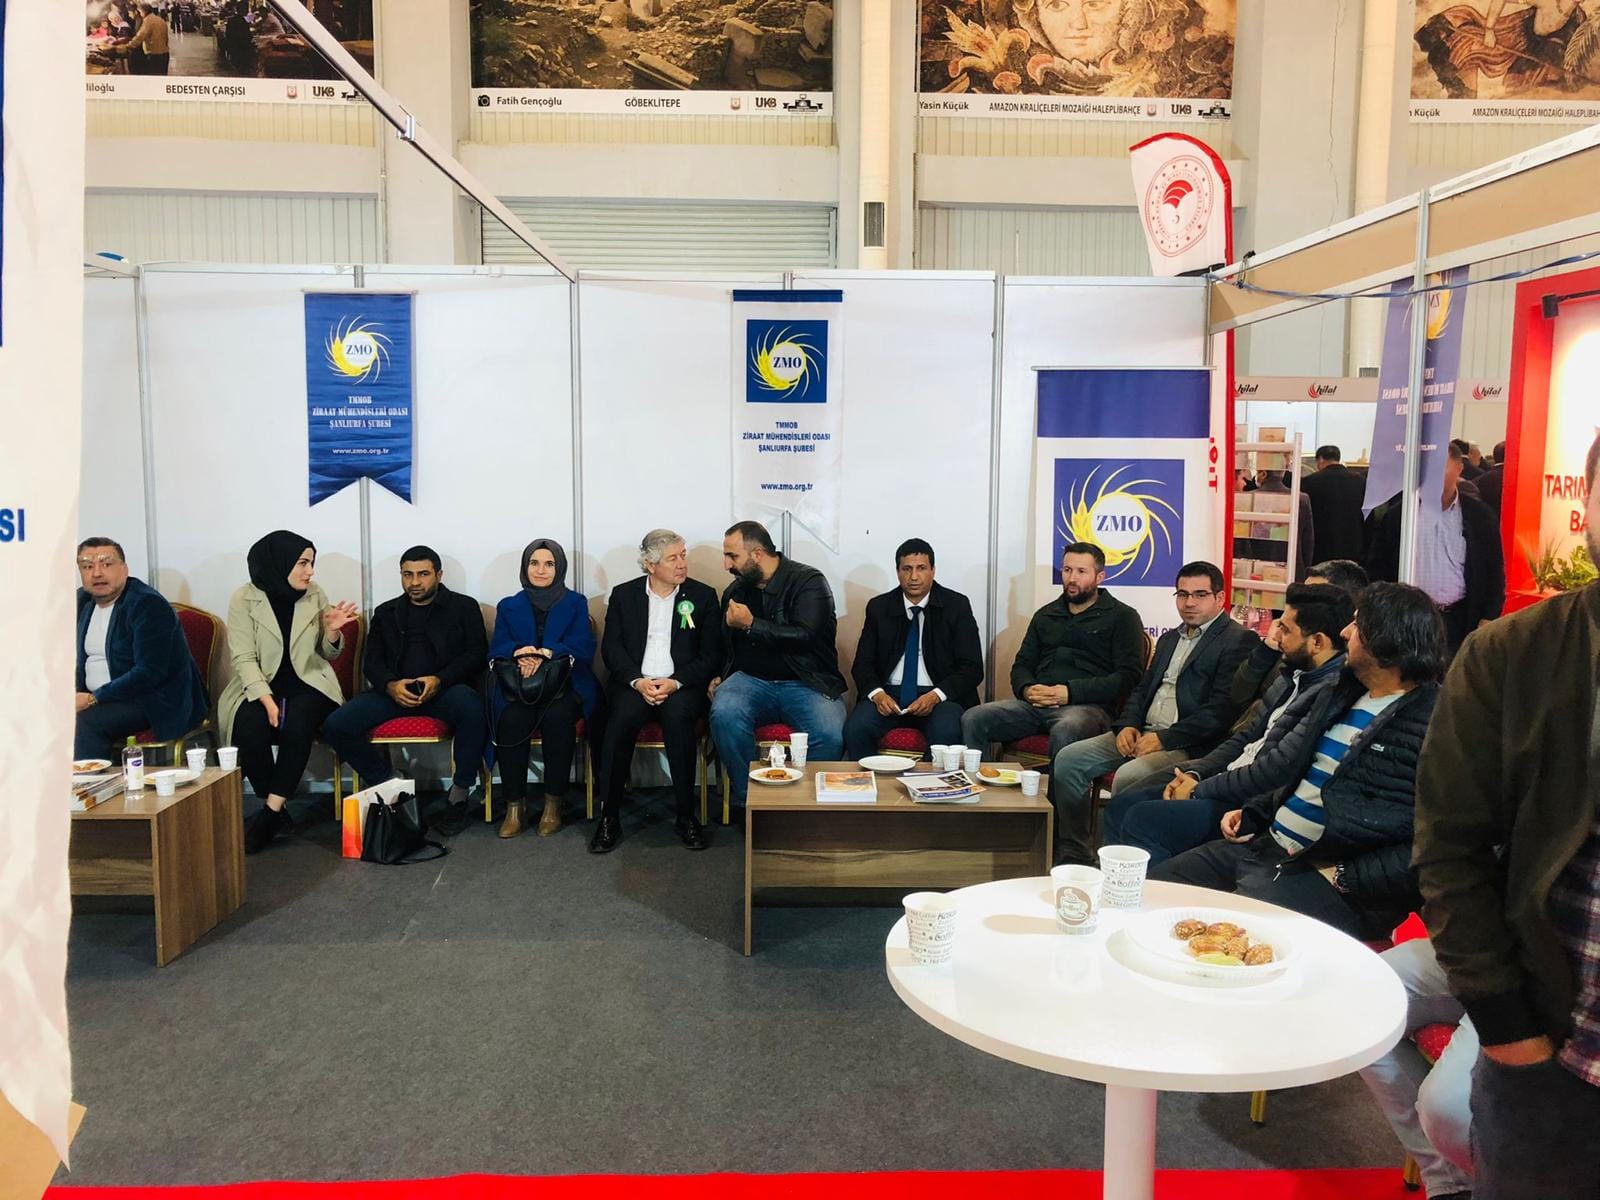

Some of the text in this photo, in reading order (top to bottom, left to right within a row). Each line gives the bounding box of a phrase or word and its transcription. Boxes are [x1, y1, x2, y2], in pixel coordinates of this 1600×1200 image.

[165, 84, 246, 97] BEDESTEN ÇARŞISI
[496, 96, 562, 108] Fatih Gençoğlu
[624, 97, 680, 108] GÖBEKLİTEPE
[920, 102, 969, 112] Yasin Küçük
[989, 102, 1140, 116] AMAZON KRALİÇELERİ MOZAİĞİ HALEPLİBAHÇE
[1414, 108, 1440, 120] Küçük
[1472, 108, 1499, 117] AMAZON
[346, 344, 372, 355] ZMO
[772, 356, 802, 368] ZMO
[312, 406, 408, 416] ZİRAAT MÜHENDİSLERİ ODASI
[330, 418, 392, 430] ŞANLIURFA ŞUBESİ
[742, 432, 764, 440] ZİRAAT
[766, 432, 811, 440] MÜHENDİSLERİ
[758, 444, 816, 453] ŞANLIURFA ŞUBESİ
[761, 482, 813, 492] www.zmo.org.tr
[1096, 516, 1142, 532] ZMO
